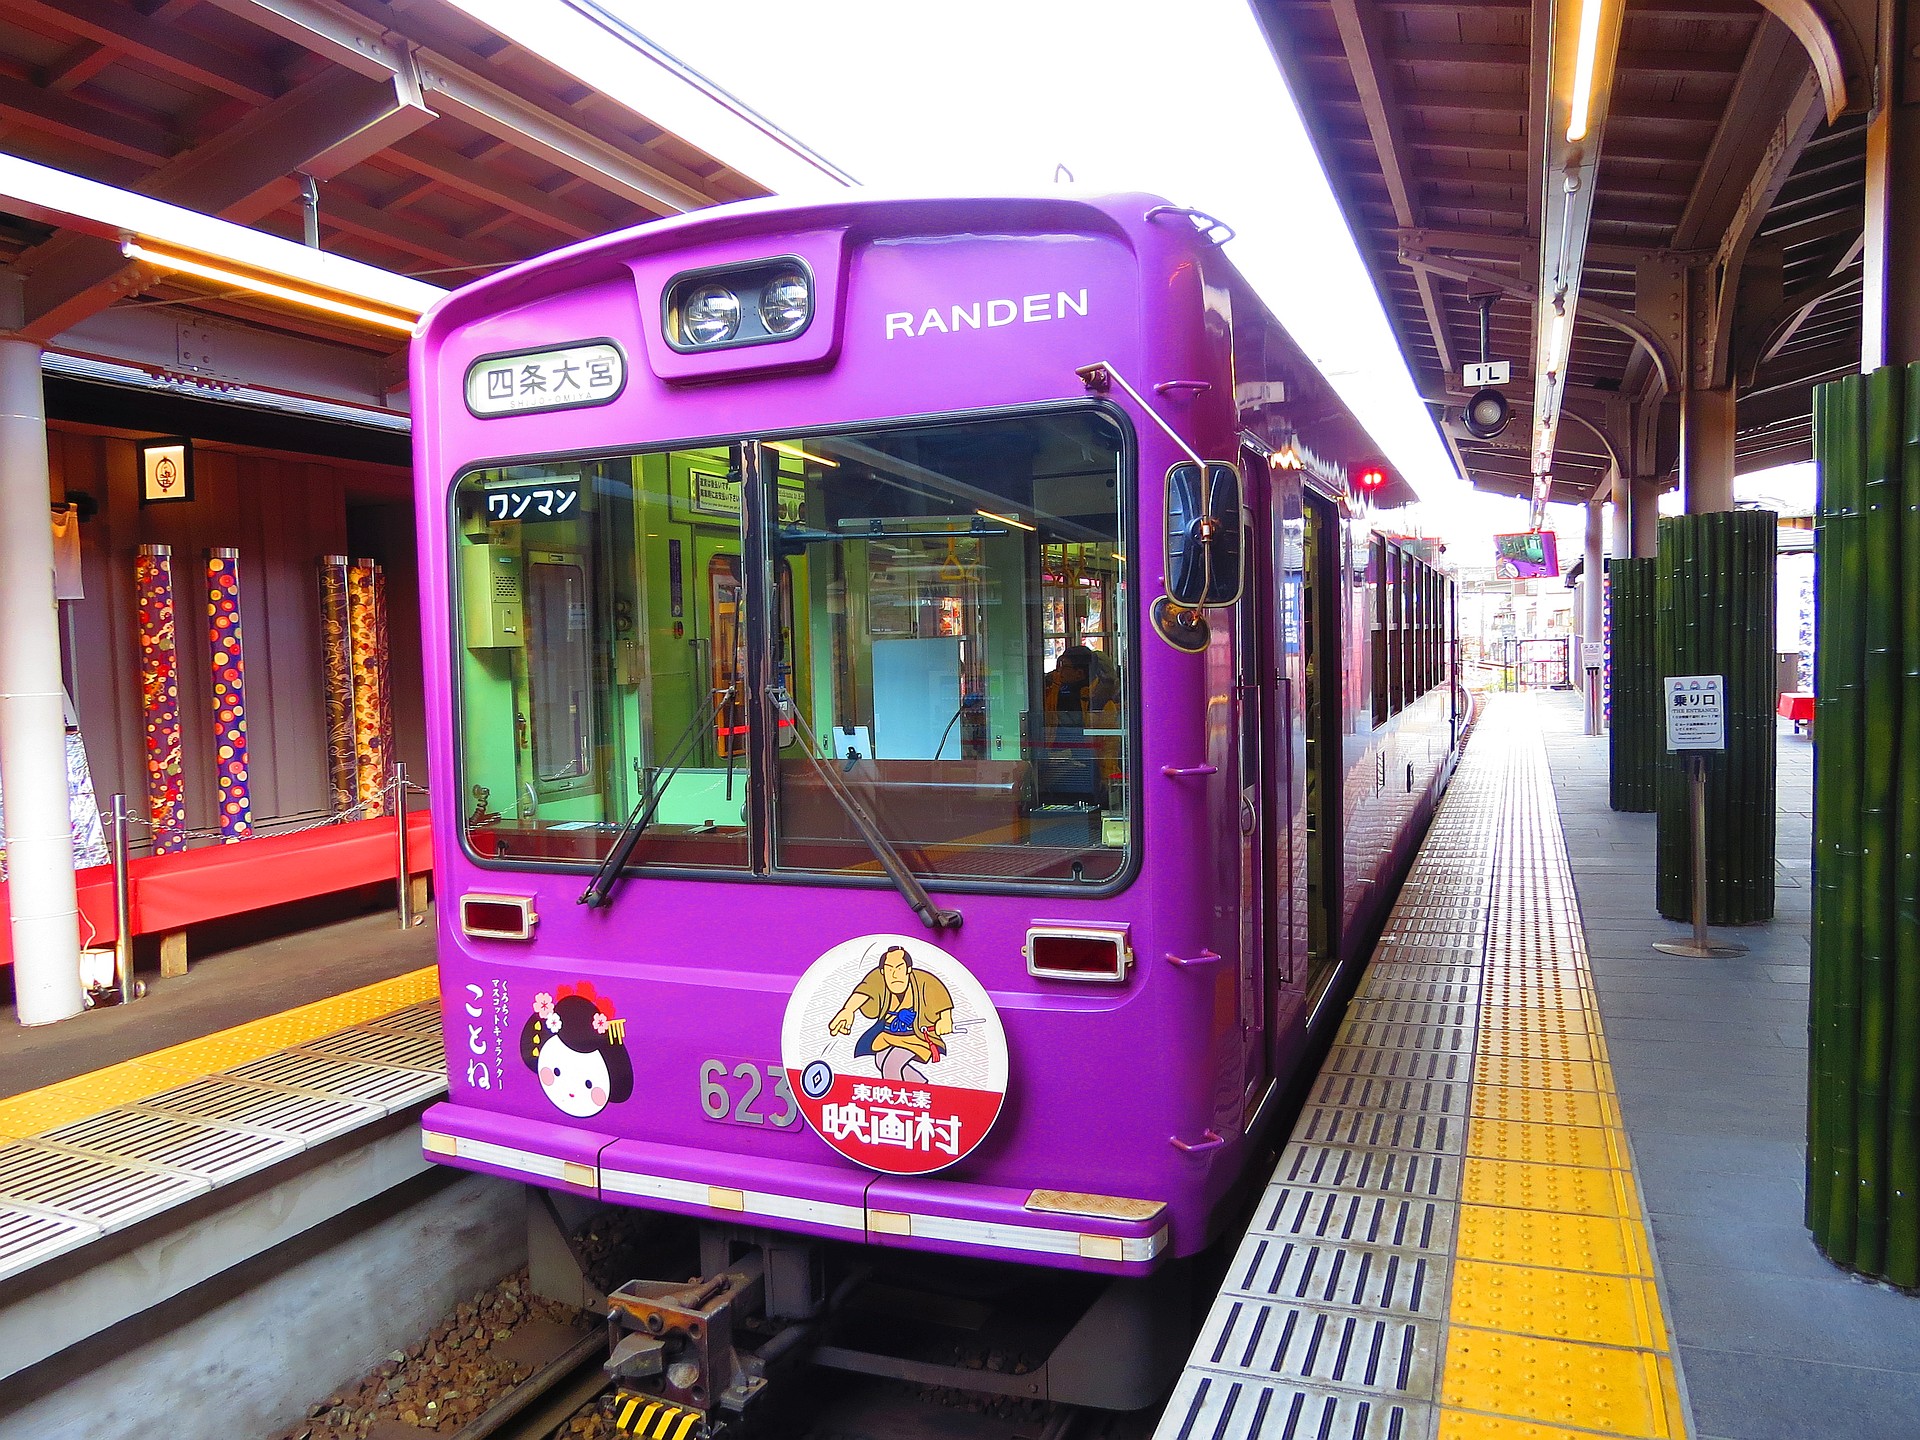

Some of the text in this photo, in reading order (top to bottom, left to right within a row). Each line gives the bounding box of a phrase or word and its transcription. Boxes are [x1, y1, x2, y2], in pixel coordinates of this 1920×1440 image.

[885, 288, 1089, 340] RANDEN
[487, 355, 615, 400] 四条大宮
[488, 489, 578, 520] ワンマン
[1673, 694, 1715, 707] 乗り口
[501, 980, 509, 1027] くろちく
[465, 983, 491, 1091] ことね
[491, 979, 503, 1091] マスコットキャラクター
[700, 1059, 798, 1128] 623
[851, 1083, 932, 1109] 東映太秦
[822, 1102, 963, 1156] 映画村
